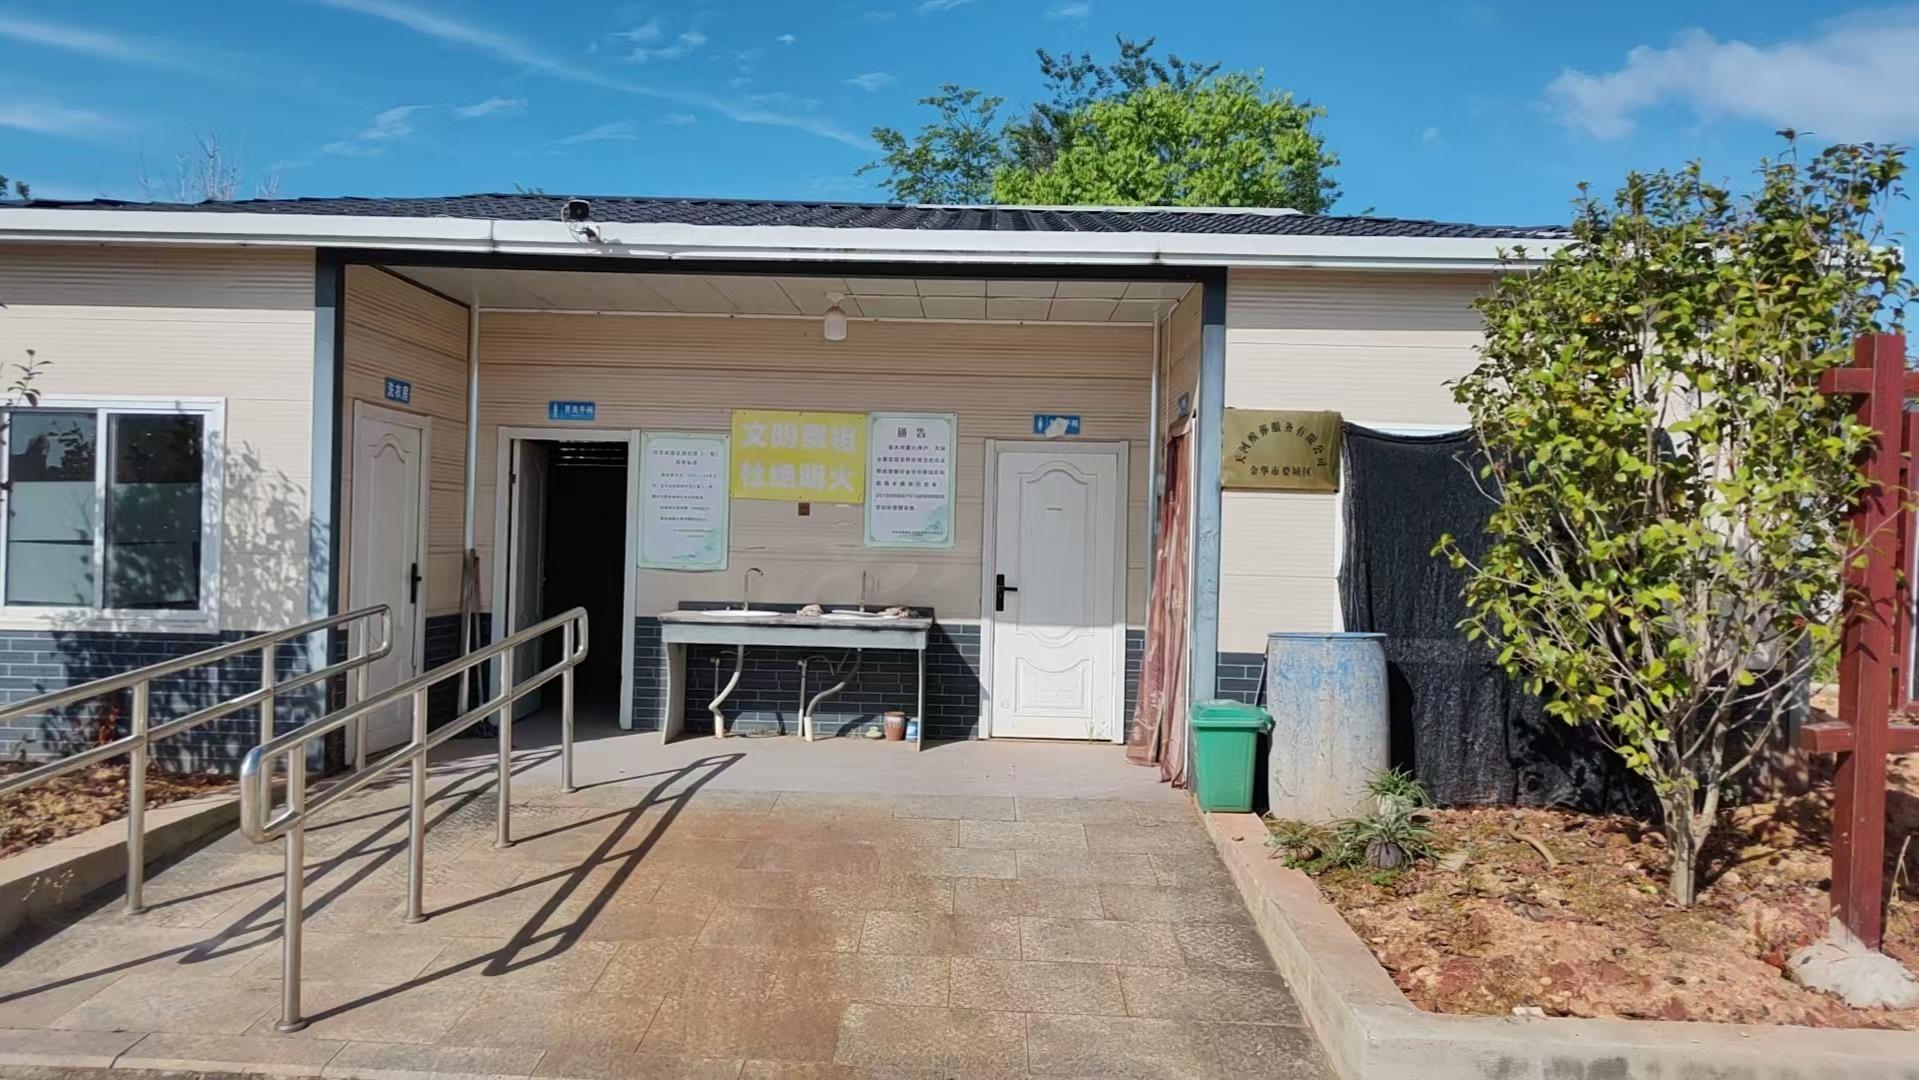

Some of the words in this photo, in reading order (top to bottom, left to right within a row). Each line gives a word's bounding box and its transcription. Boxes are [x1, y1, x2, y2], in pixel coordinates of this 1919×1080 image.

[387, 382, 409, 401] 洗衣房
[740, 422, 855, 450] 文明祭祀
[740, 460, 857, 492] 杜绝明火
[1249, 464, 1313, 477] 金华市婺城区
